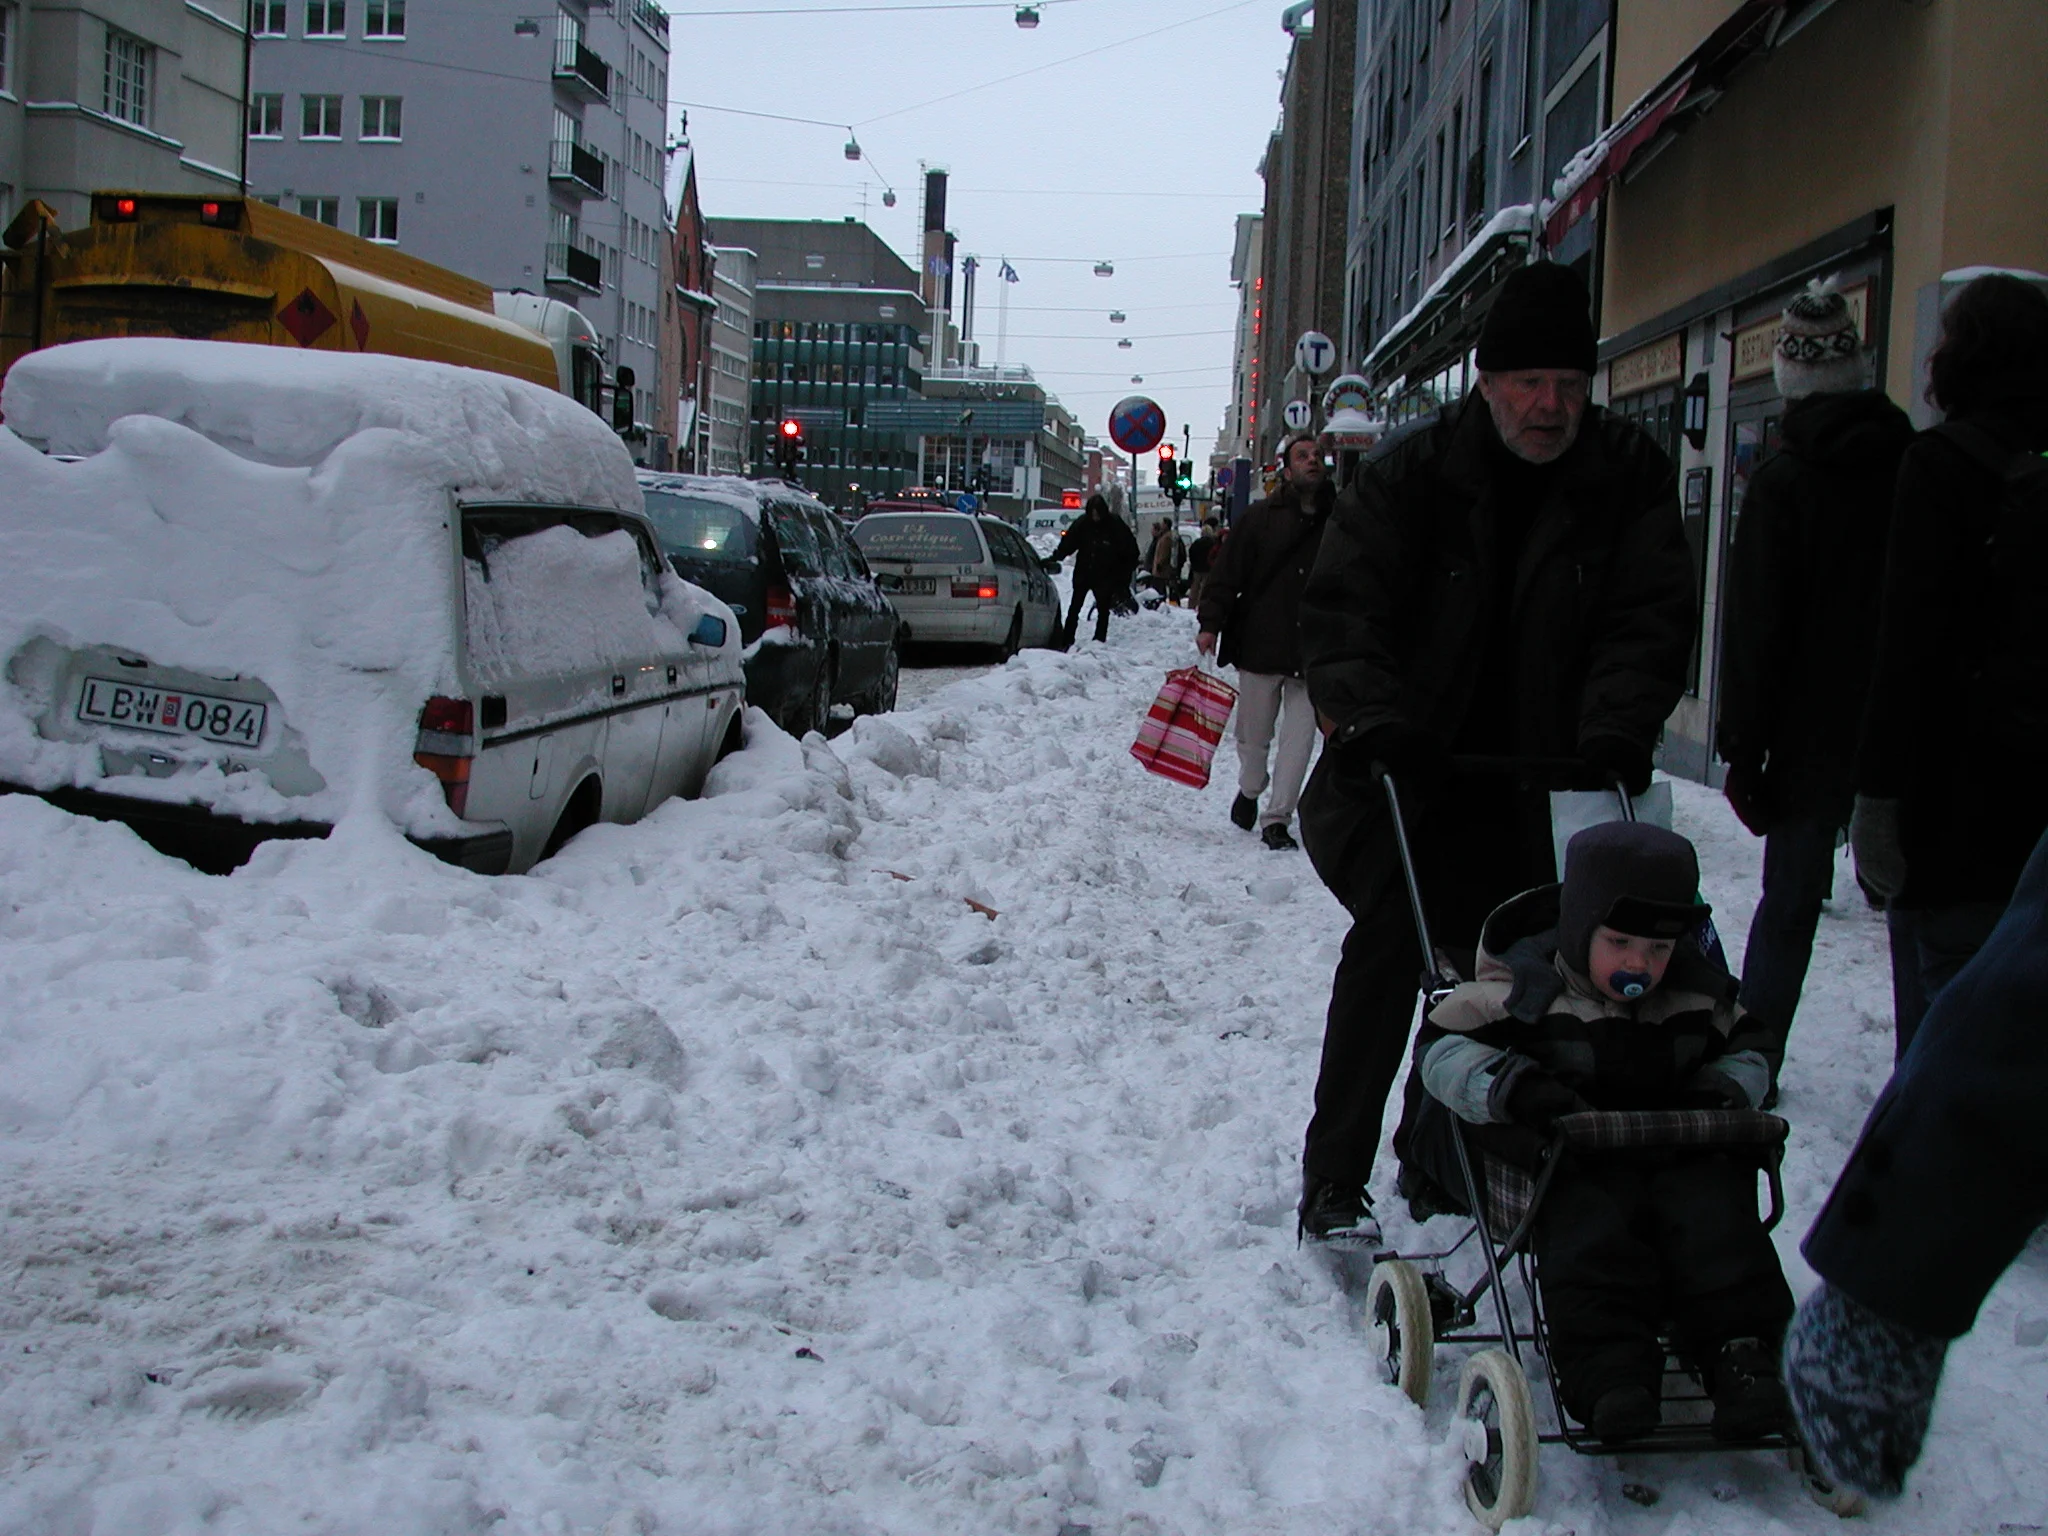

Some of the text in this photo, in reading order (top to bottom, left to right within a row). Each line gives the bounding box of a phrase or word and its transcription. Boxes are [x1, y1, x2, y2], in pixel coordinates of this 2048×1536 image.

[1310, 342, 1328, 367] T
[86, 684, 159, 724] LBW
[185, 700, 255, 740] 084
